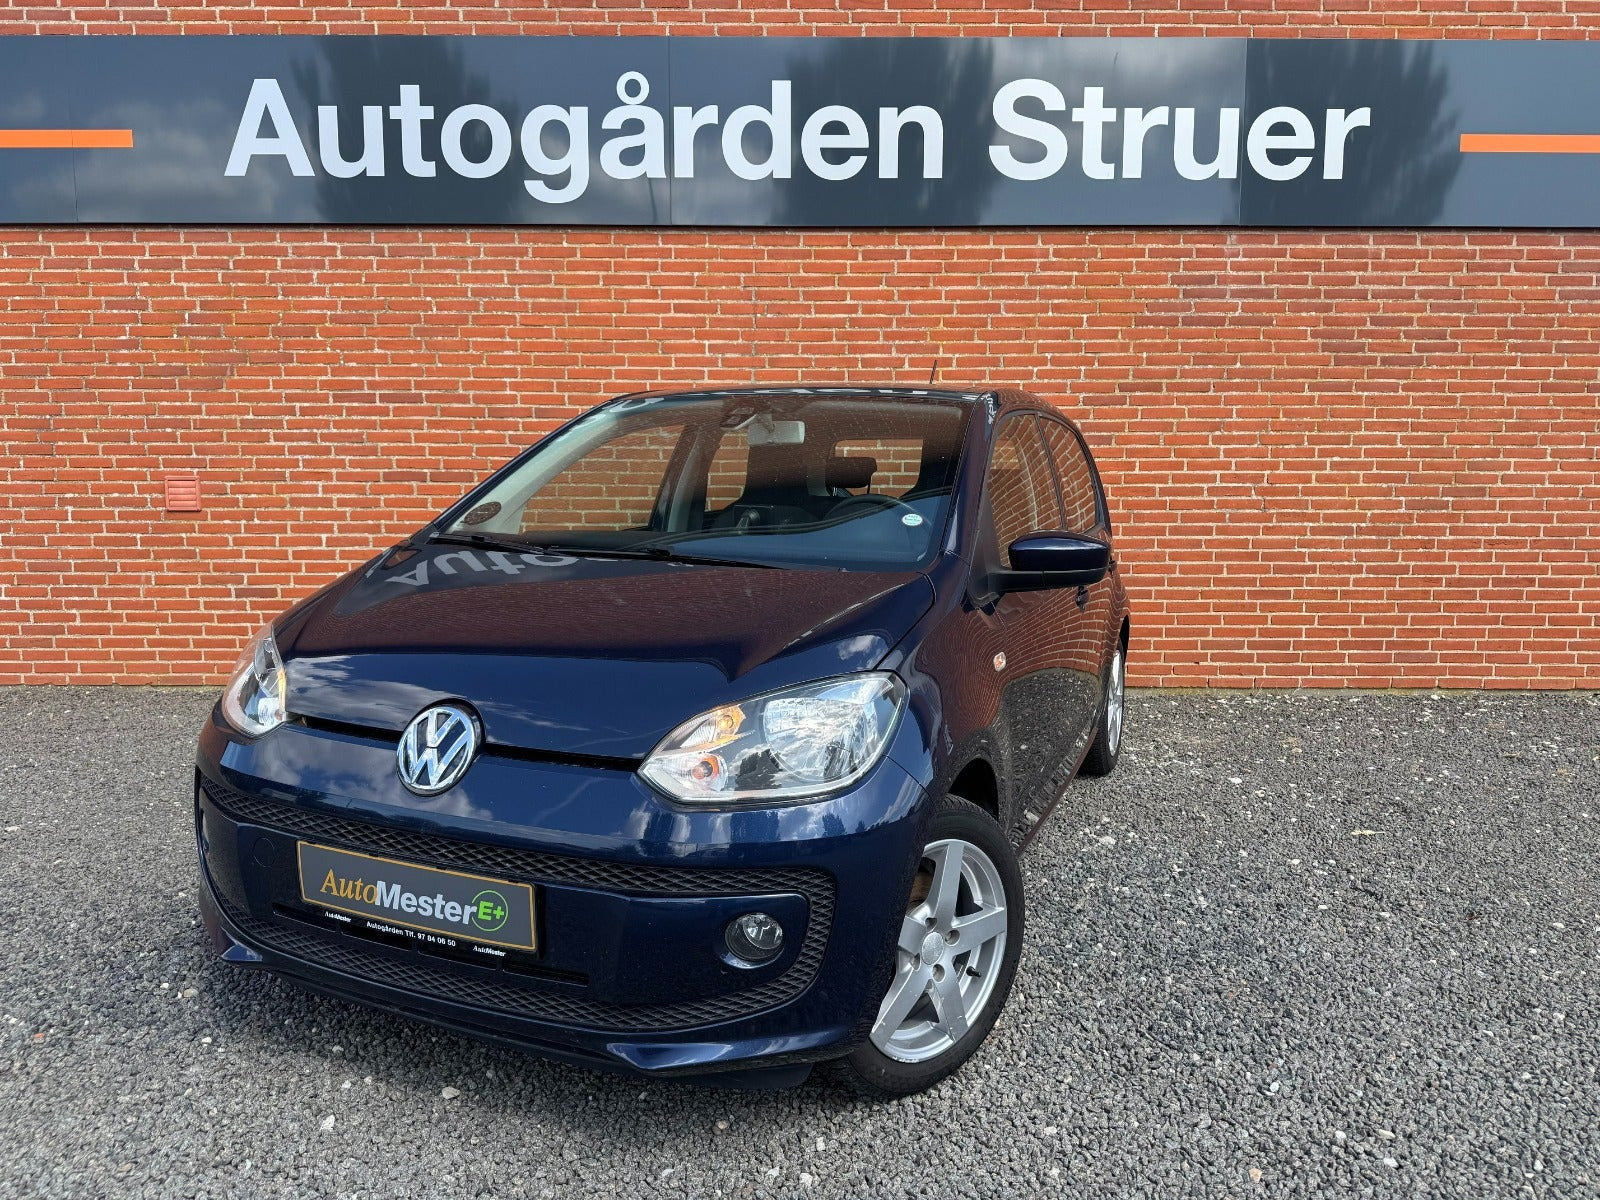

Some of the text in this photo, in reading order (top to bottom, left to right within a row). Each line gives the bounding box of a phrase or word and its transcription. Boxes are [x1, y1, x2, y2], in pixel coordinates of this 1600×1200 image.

[224, 71, 1371, 204] Autogården Struer
[320, 868, 477, 925] AutoMester
[366, 921, 404, 936] Autogården
[417, 932, 426, 941] 97
[437, 937, 446, 946] 06
[447, 939, 456, 948] 50
